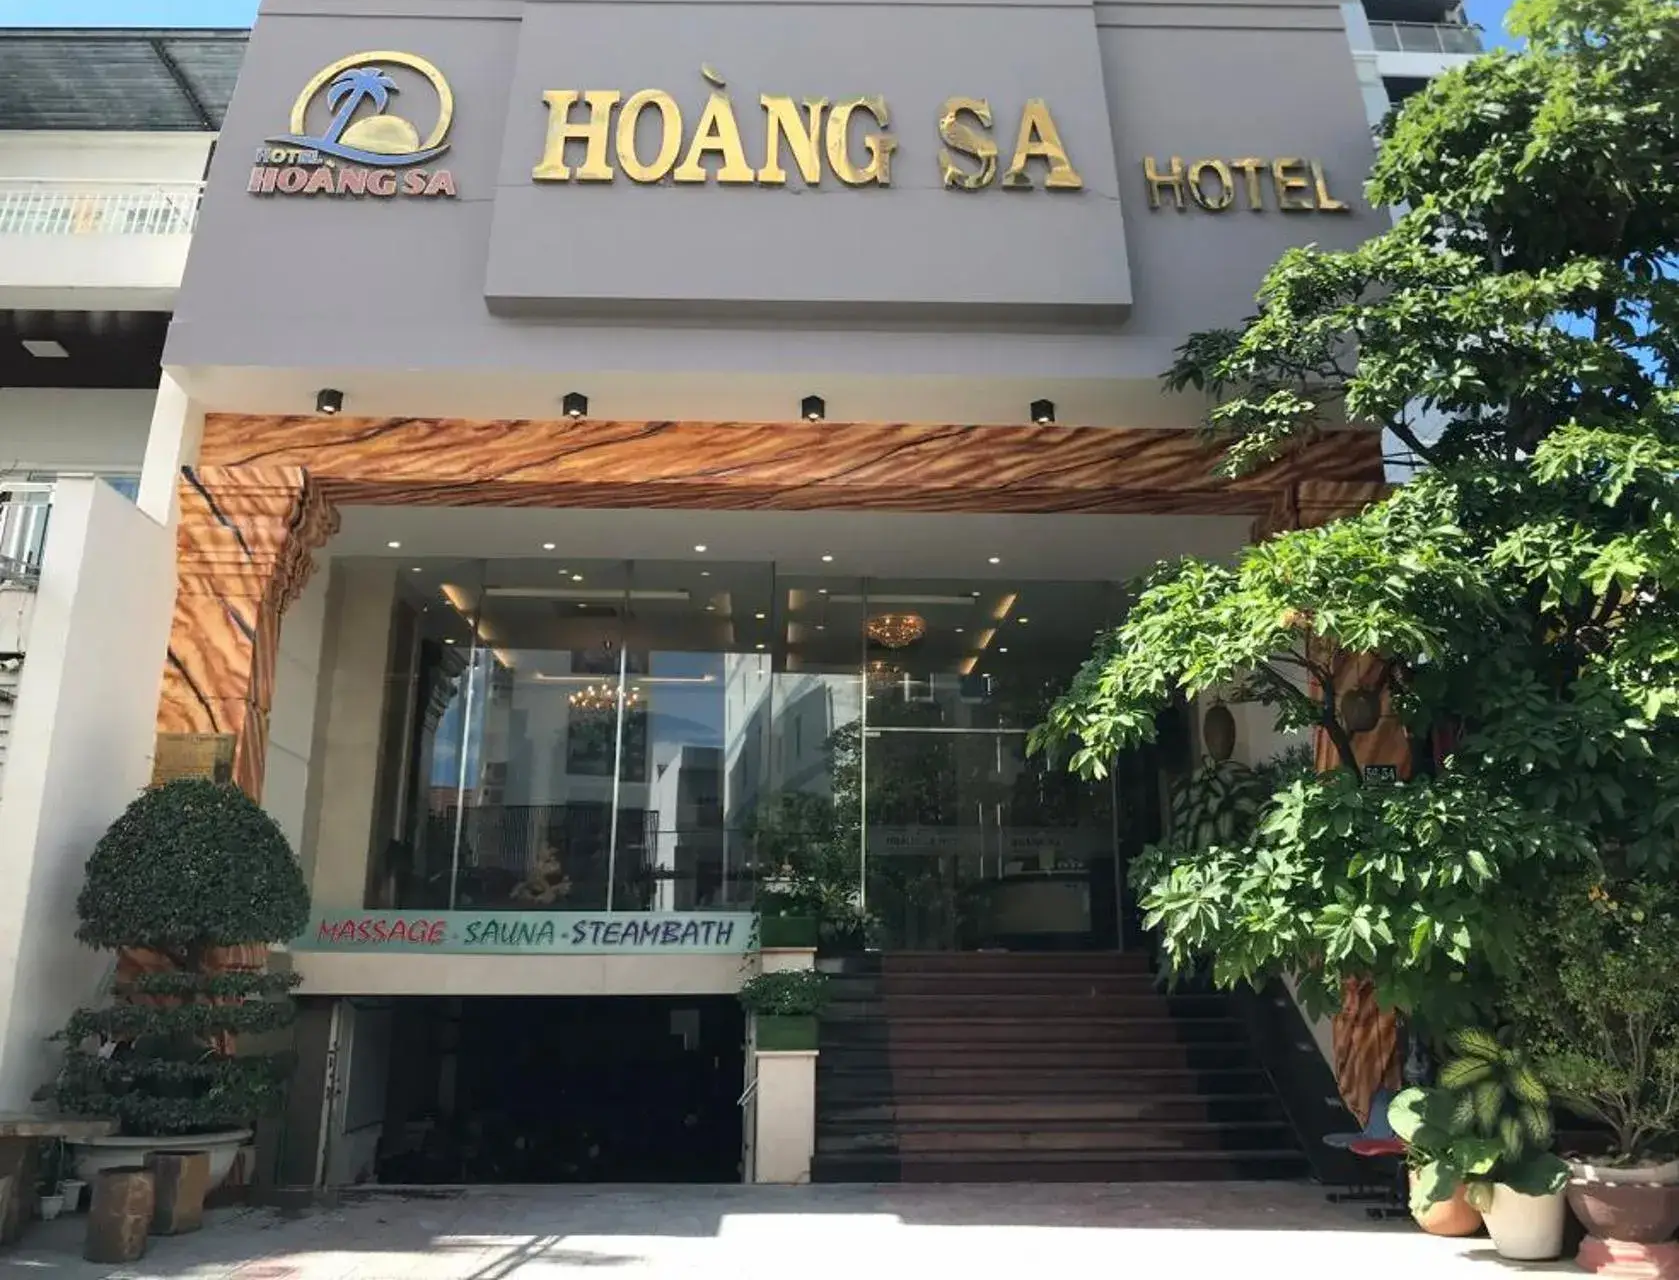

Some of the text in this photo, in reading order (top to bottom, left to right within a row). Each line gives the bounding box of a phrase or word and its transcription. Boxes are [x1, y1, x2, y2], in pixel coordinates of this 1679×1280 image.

[532, 62, 1084, 191] HOÀNG SA
[255, 147, 323, 166] HOTEL
[247, 160, 457, 197] HOÀNG SA
[1144, 155, 1350, 213] HOTEL
[317, 917, 734, 946] MASSAGE SAUNA STEAMBATH
